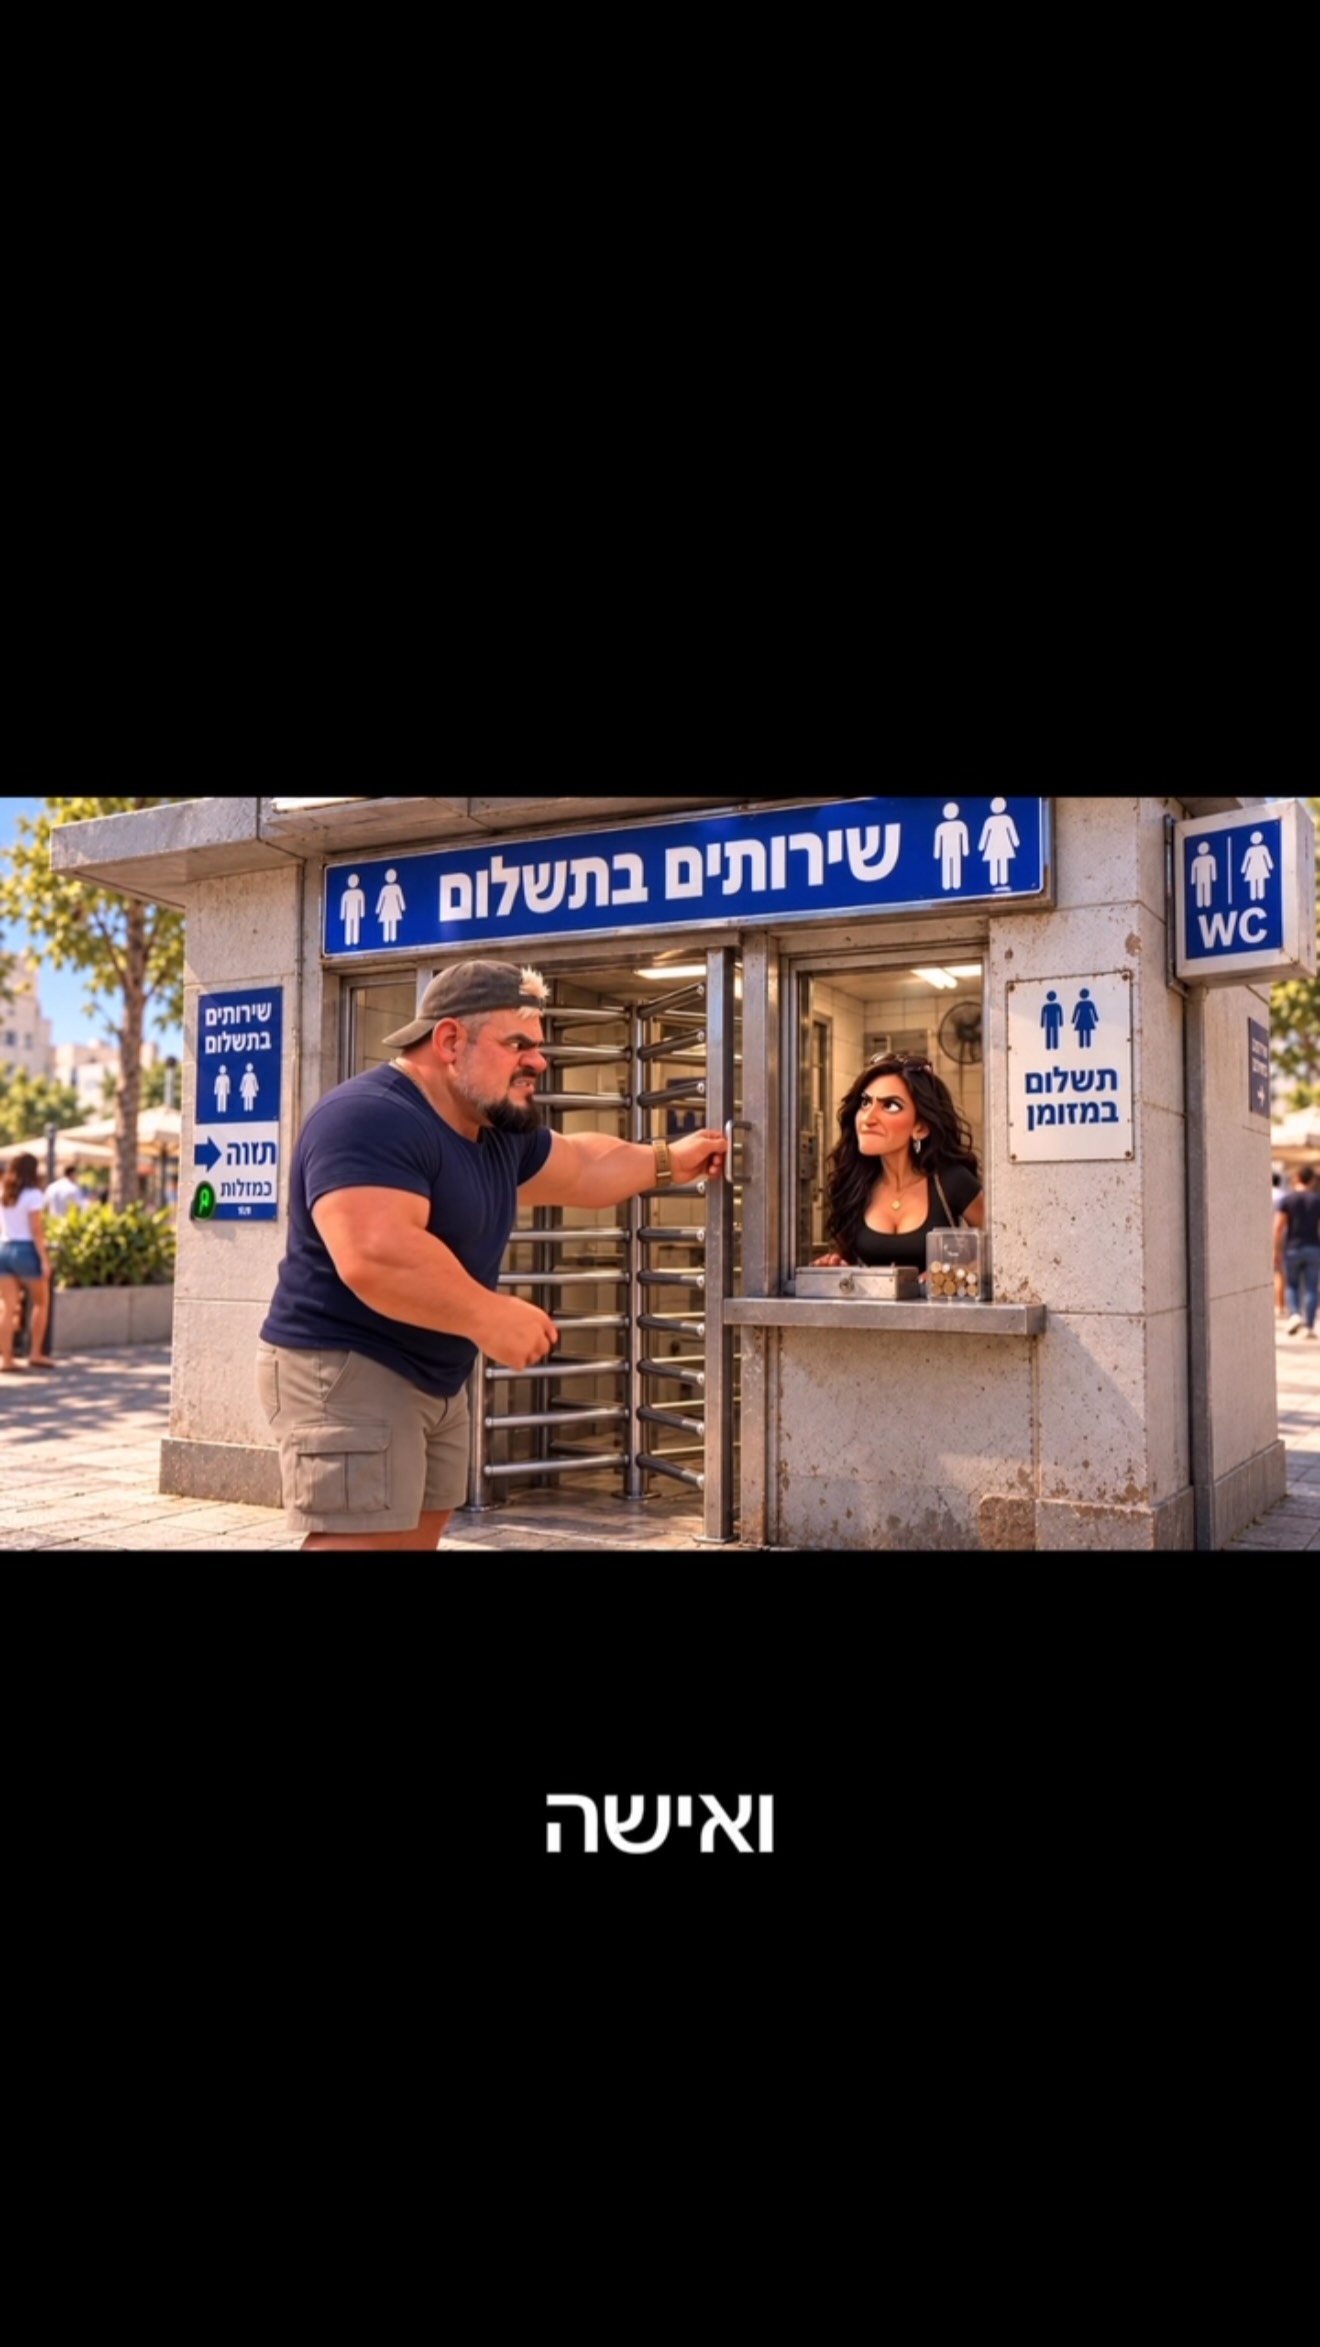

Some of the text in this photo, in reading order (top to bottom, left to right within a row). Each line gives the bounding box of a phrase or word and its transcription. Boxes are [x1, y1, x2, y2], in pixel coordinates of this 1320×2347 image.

[439, 823, 901, 922] שירותים בתשלום
[1198, 906, 1268, 949] WC
[205, 1002, 272, 1027] שירותים
[205, 1031, 272, 1054] בתשלום
[1025, 1066, 1118, 1094] תשלום
[1027, 1101, 1119, 1131] במזומן
